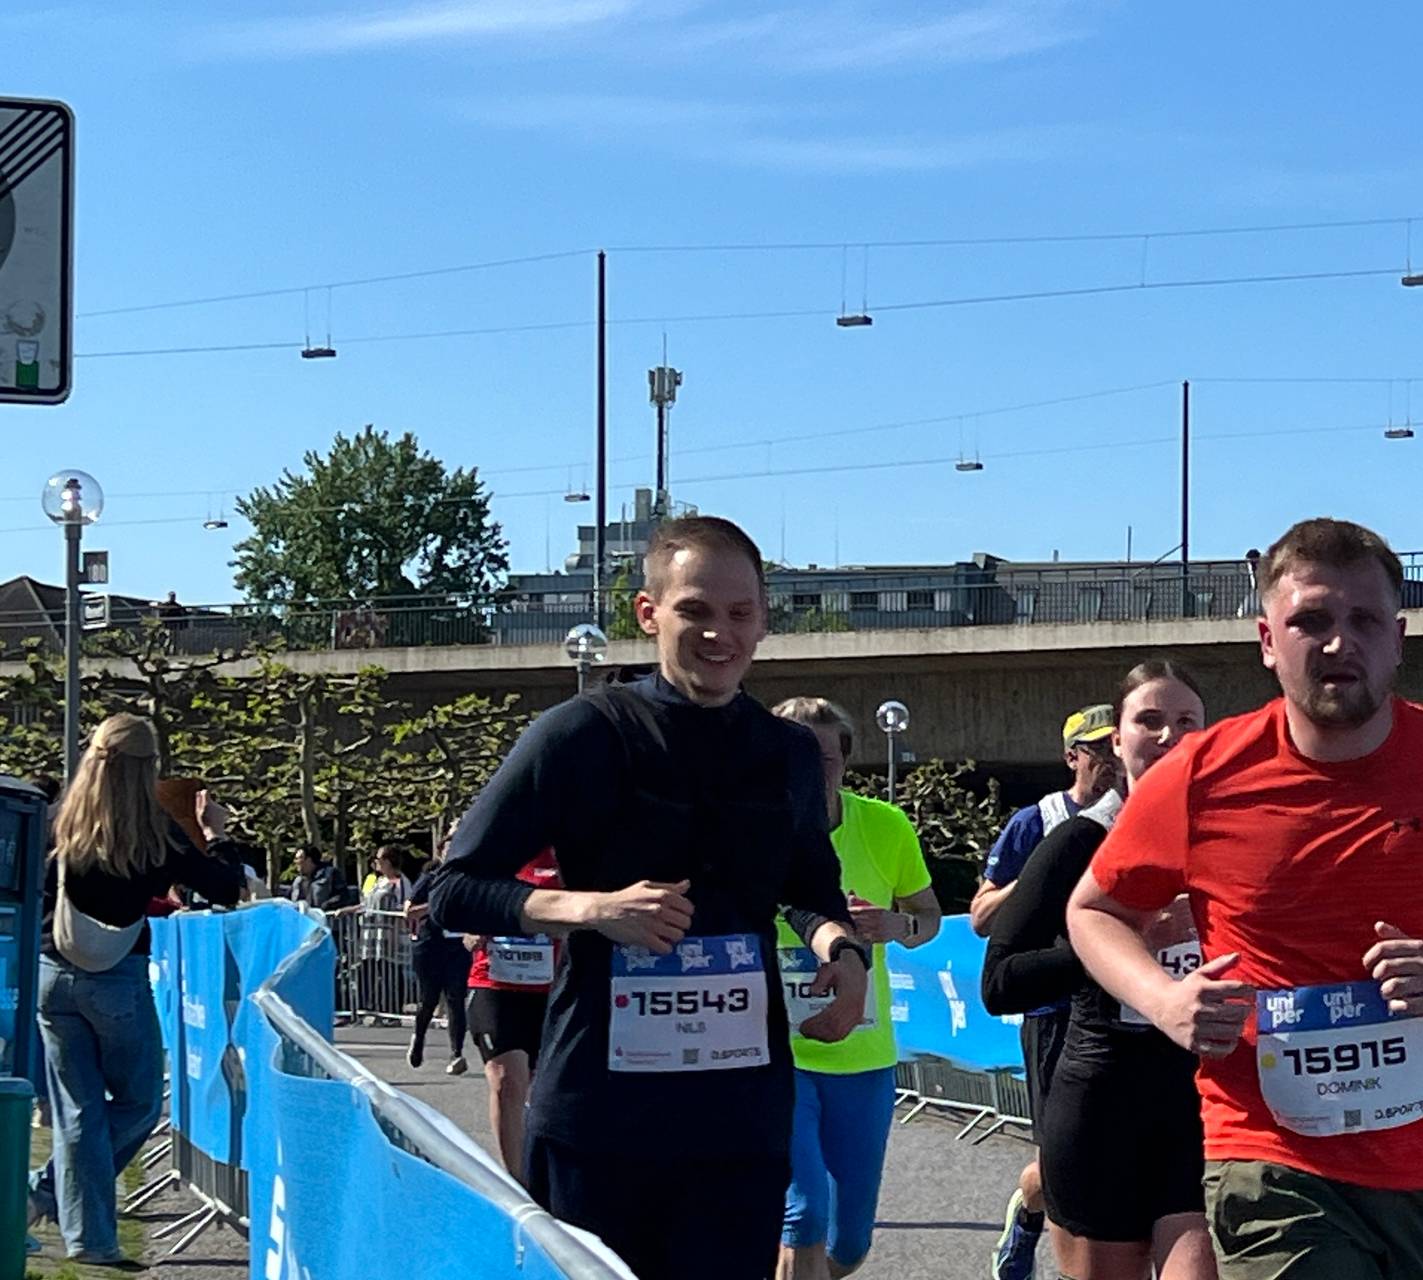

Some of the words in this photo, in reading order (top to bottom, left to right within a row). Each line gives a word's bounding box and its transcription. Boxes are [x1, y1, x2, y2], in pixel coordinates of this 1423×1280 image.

[632, 988, 749, 1016] 15543
[1267, 992, 1294, 1011] uni
[1271, 1008, 1304, 1028] per
[1330, 1002, 1366, 1023] per
[1284, 1037, 1407, 1076] 15915
